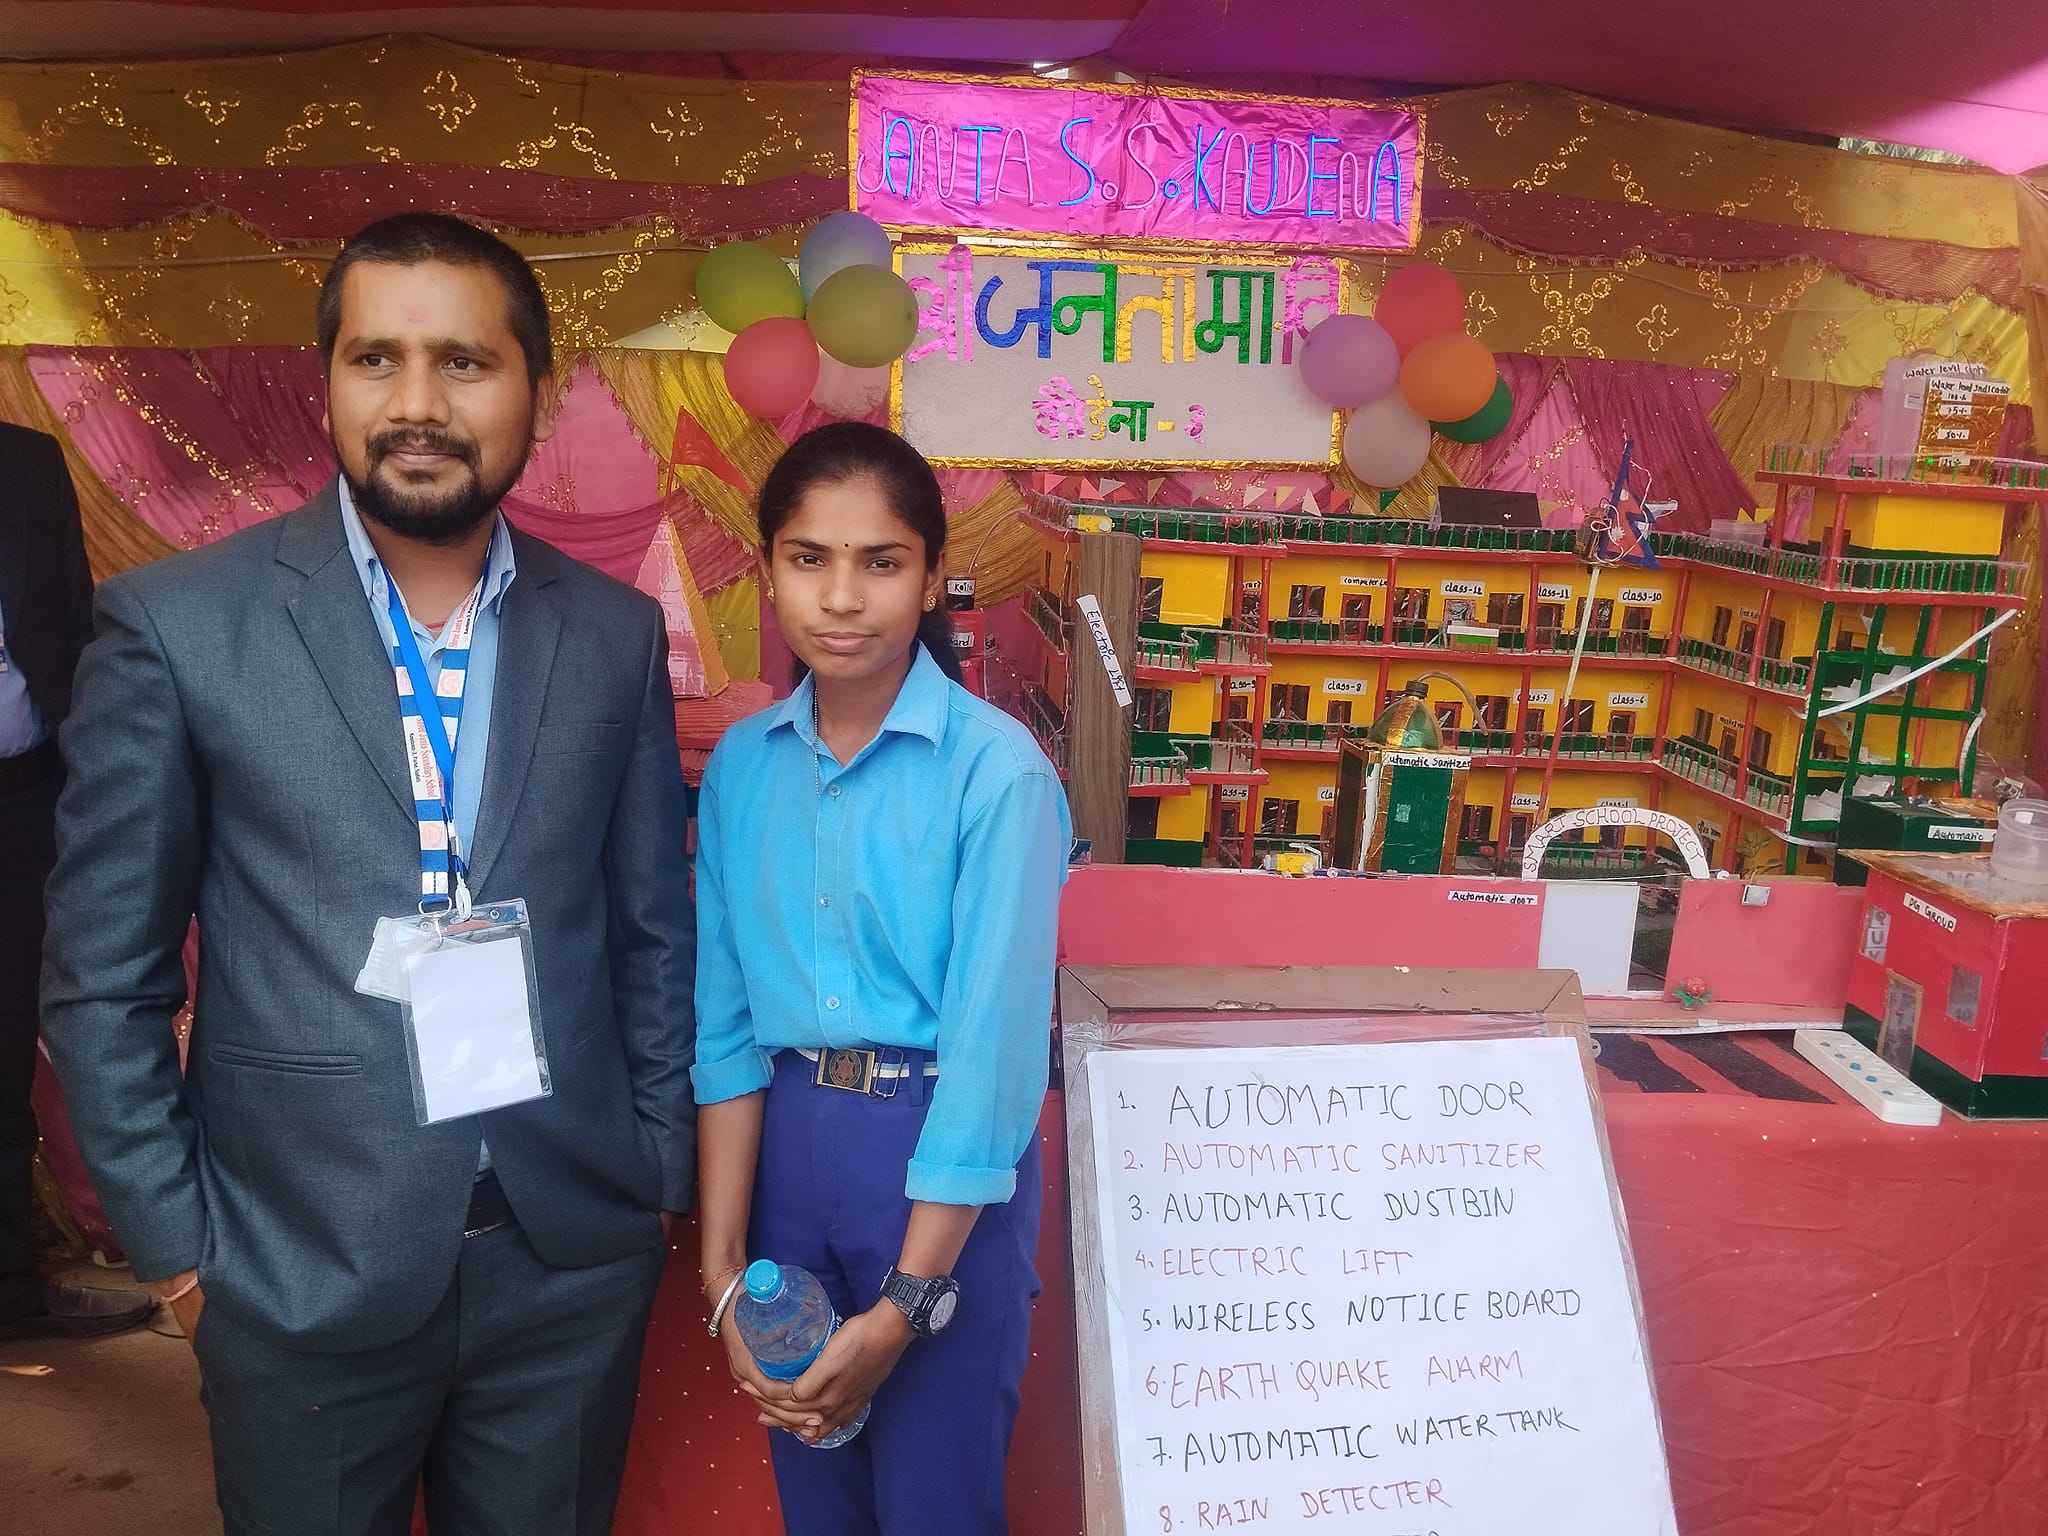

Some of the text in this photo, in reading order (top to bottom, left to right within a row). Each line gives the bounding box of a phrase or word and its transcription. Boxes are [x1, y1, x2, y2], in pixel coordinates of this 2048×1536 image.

[857, 110, 1034, 205] JANTA
[1195, 125, 1402, 224] KAUDENA
[1444, 582, 1483, 596] class-12
[1538, 585, 1570, 599] lass-11
[1622, 589, 1662, 602] class-10
[1327, 680, 1362, 692] class-8
[1612, 694, 1645, 705] class-6
[1523, 808, 1704, 873] SMART SCHOOL PROJECT
[1933, 829, 1985, 841] Automatic
[1452, 891, 1535, 905] Automatic door
[1118, 1080, 1533, 1129] 1. AUTOMATIC DOOR
[1123, 1142, 1546, 1177] 2. AUTOMATIC SANITIZER
[1128, 1186, 1515, 1224] 3. AUTOMATIC DUSTBIN
[1134, 1246, 1413, 1277] 4. ELECTRIC LIFT
[1142, 1288, 1582, 1333] 5. WIRELESS NOTICE BOARD
[1145, 1349, 1524, 1409] 6. EARTH QUAKE ALARM
[1145, 1406, 1582, 1473] 7. AUTOMATIC WATER TANK
[1158, 1477, 1454, 1534] 8. RAIN DETECTER
